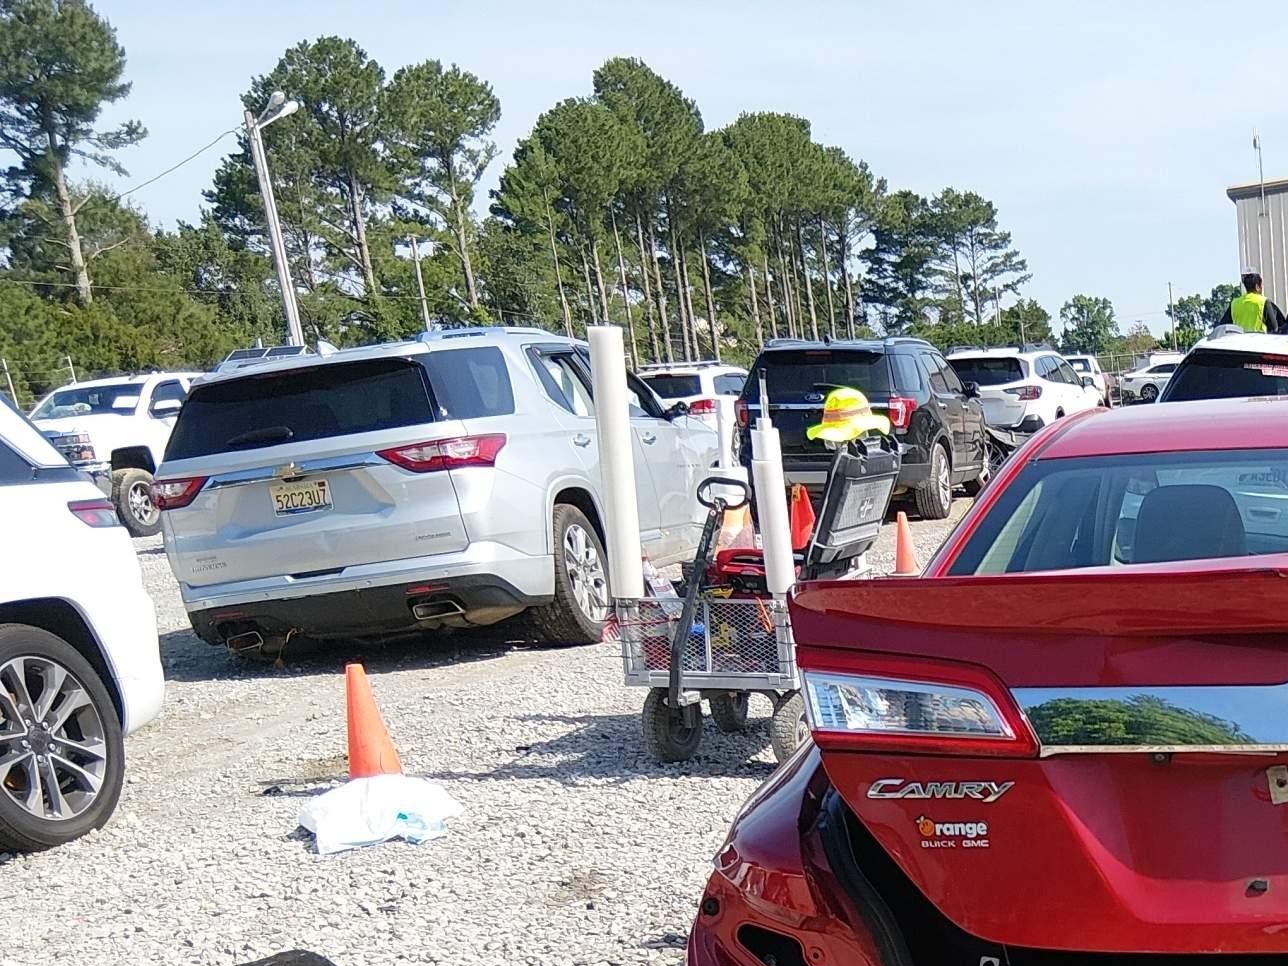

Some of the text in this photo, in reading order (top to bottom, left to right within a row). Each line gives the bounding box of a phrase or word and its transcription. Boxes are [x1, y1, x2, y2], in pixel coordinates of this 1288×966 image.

[275, 488, 327, 510] 52C23U7
[867, 778, 1016, 803] CAMRY
[921, 839, 990, 848] BUICK GMC
